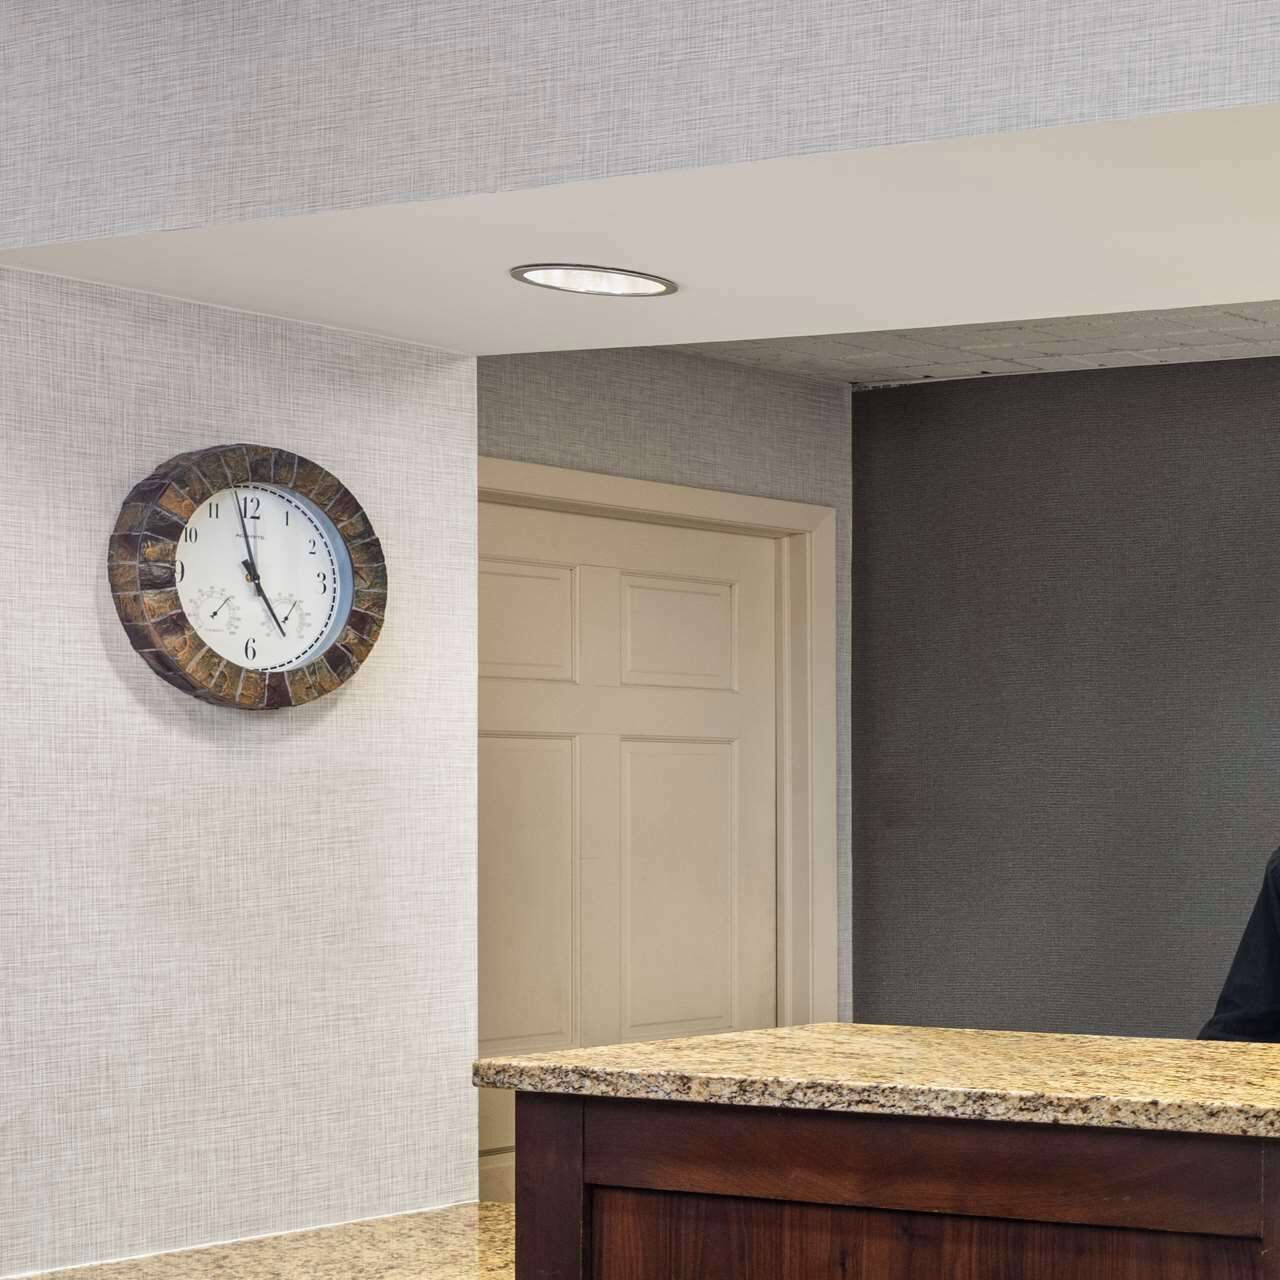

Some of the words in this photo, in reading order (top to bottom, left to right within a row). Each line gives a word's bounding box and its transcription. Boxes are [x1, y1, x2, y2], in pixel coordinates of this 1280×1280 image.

[208, 503, 219, 519] 11
[243, 496, 260, 519] 12
[184, 526, 198, 543] 10
[307, 538, 317, 555] 2
[316, 571, 327, 594] 3
[244, 637, 256, 660] 6
